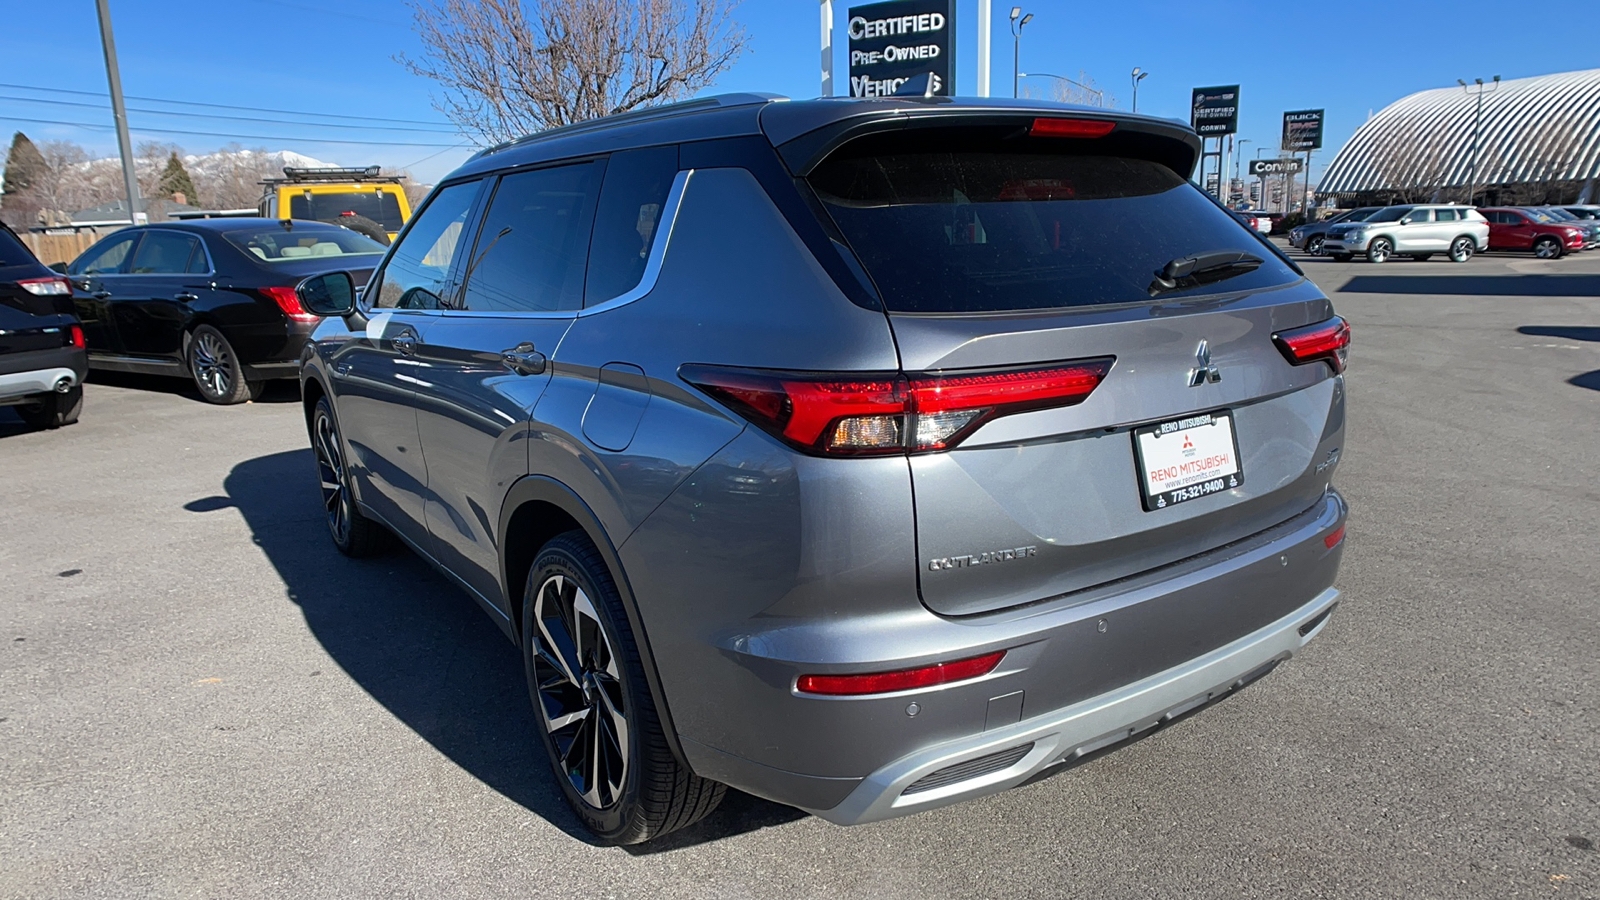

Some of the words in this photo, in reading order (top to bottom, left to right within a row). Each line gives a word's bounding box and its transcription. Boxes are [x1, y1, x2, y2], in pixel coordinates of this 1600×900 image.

[848, 13, 945, 39] CERTIFIED
[851, 45, 940, 66] PRE-OWNED
[1161, 421, 1178, 433] RENO
[1179, 414, 1211, 429] MITSUBISHI
[1151, 466, 1178, 483] RENO
[1180, 453, 1229, 475] MITSUBISHI
[1165, 469, 1220, 489] www.renomits.com
[1171, 479, 1224, 503] 775-321-9400
[928, 546, 1036, 571] OUTLANDER
